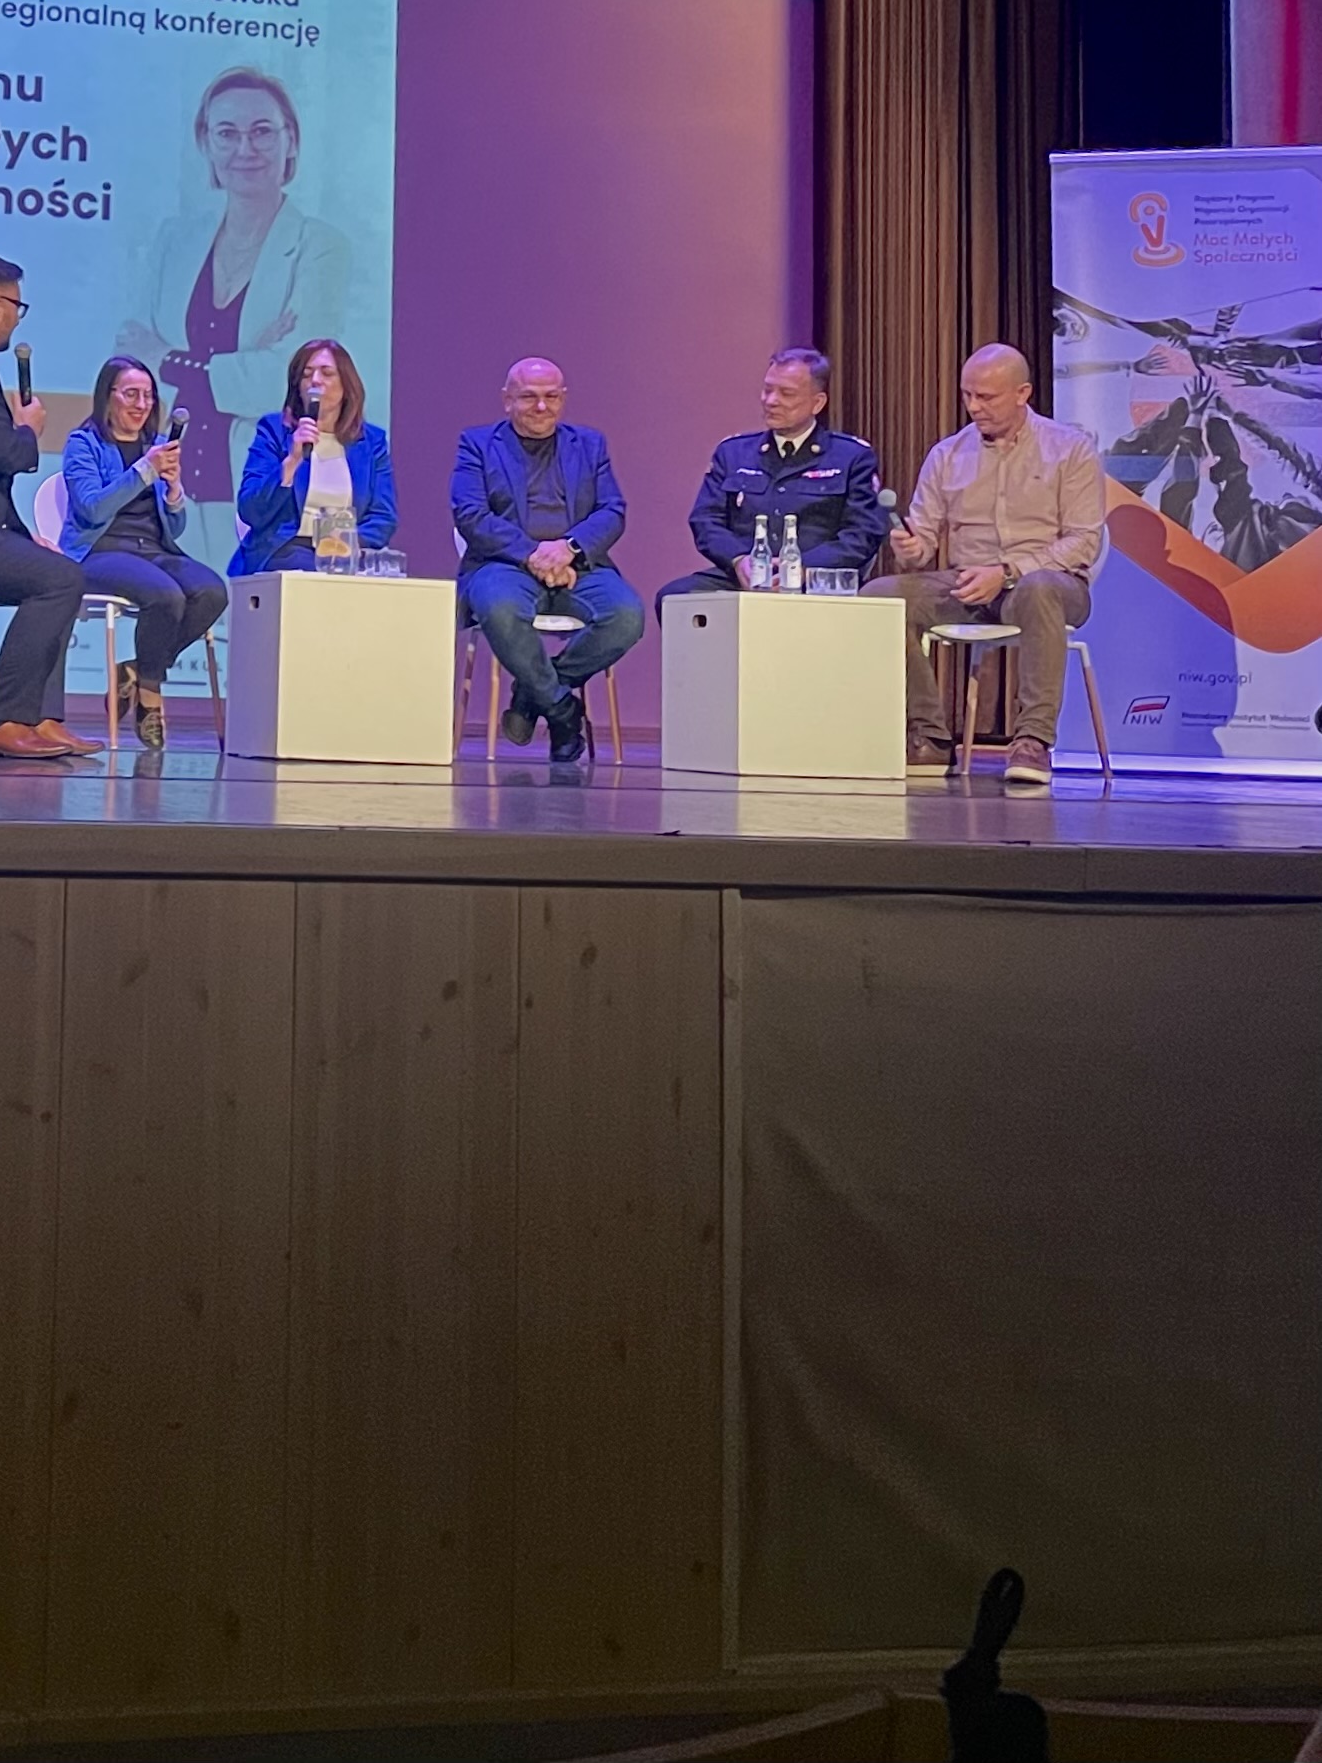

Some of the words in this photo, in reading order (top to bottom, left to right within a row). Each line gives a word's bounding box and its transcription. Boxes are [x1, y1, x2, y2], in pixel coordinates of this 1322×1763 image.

[155, 8, 320, 47] konferencję
[1178, 669, 1253, 686] niw.gov.pl
[1130, 713, 1163, 725] NIW
